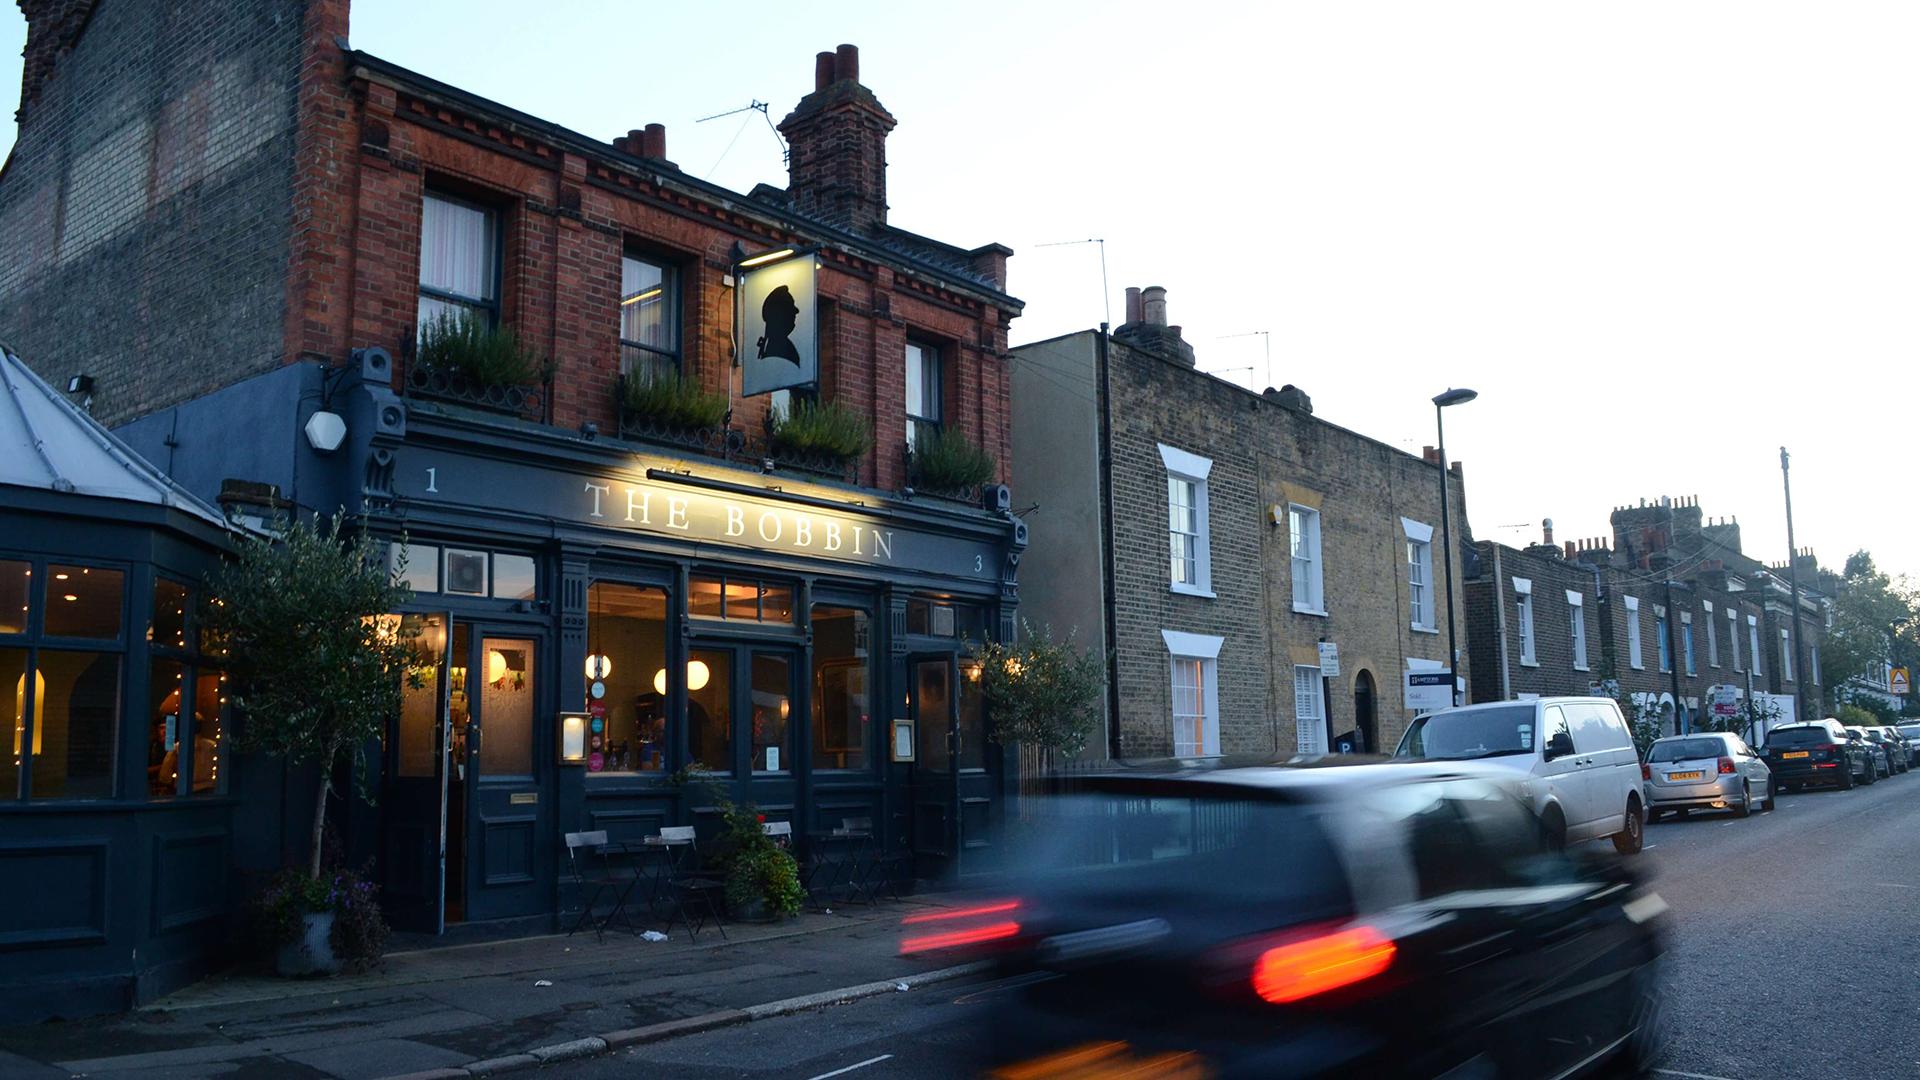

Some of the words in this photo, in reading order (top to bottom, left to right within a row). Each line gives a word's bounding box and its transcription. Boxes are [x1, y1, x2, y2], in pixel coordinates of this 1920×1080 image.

[425, 467, 439, 493] 1
[584, 481, 690, 530] THE
[724, 504, 894, 560] BOBBIN
[974, 554, 983, 573] 3
[1342, 743, 1351, 755] P
